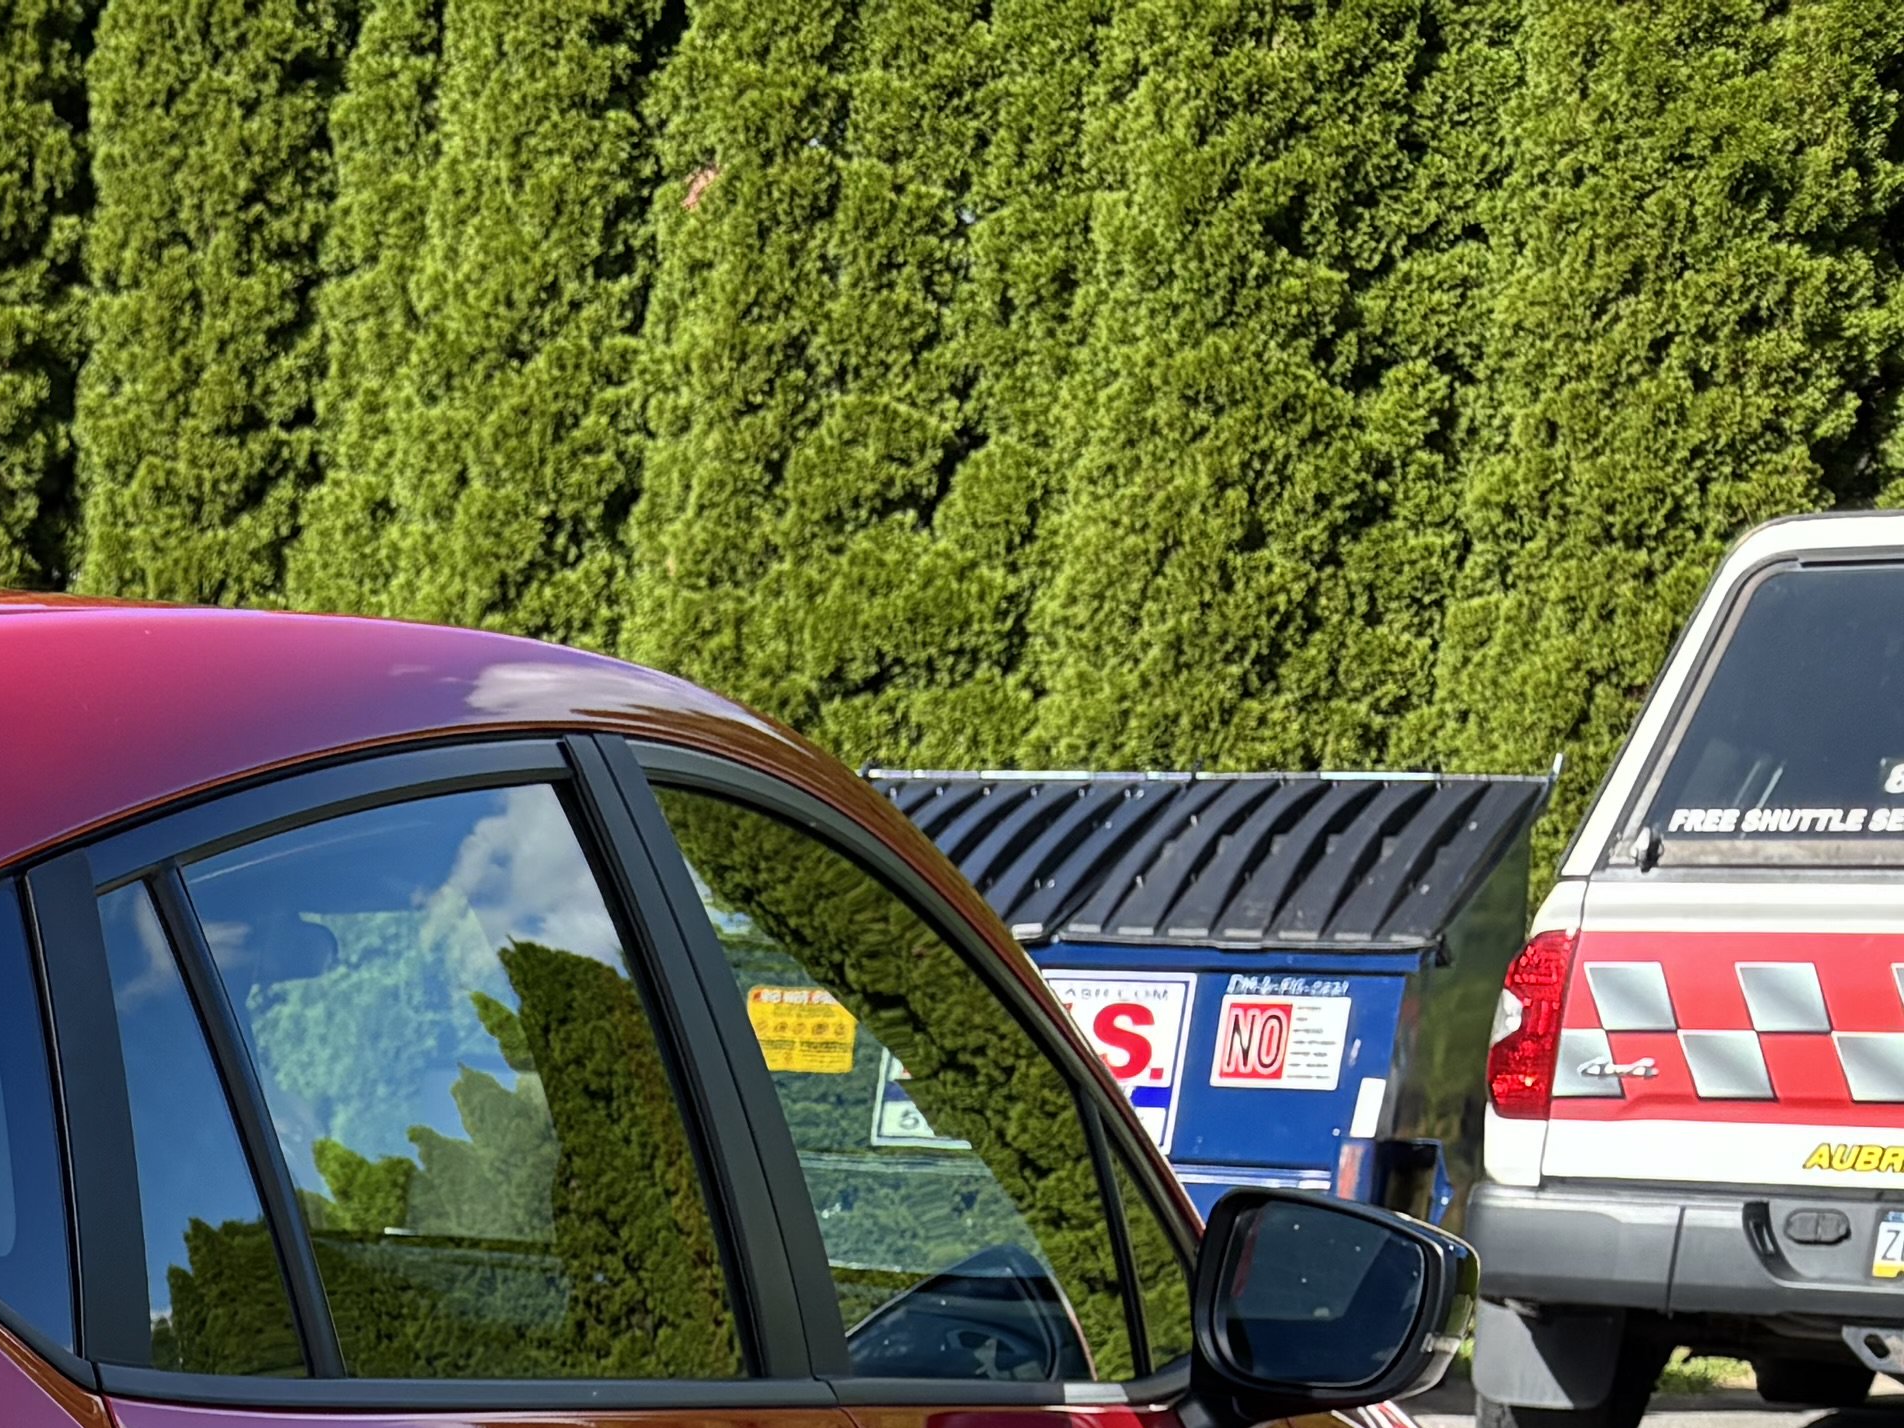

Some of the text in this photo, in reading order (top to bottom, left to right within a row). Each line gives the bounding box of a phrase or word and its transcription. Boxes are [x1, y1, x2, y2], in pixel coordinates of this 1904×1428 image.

[1668, 808, 1904, 833] FREE SHUTTLE SE
[1222, 1007, 1288, 1075] NO
[1802, 1142, 1904, 1173] AUBR
[1881, 1229, 1904, 1261] Z
